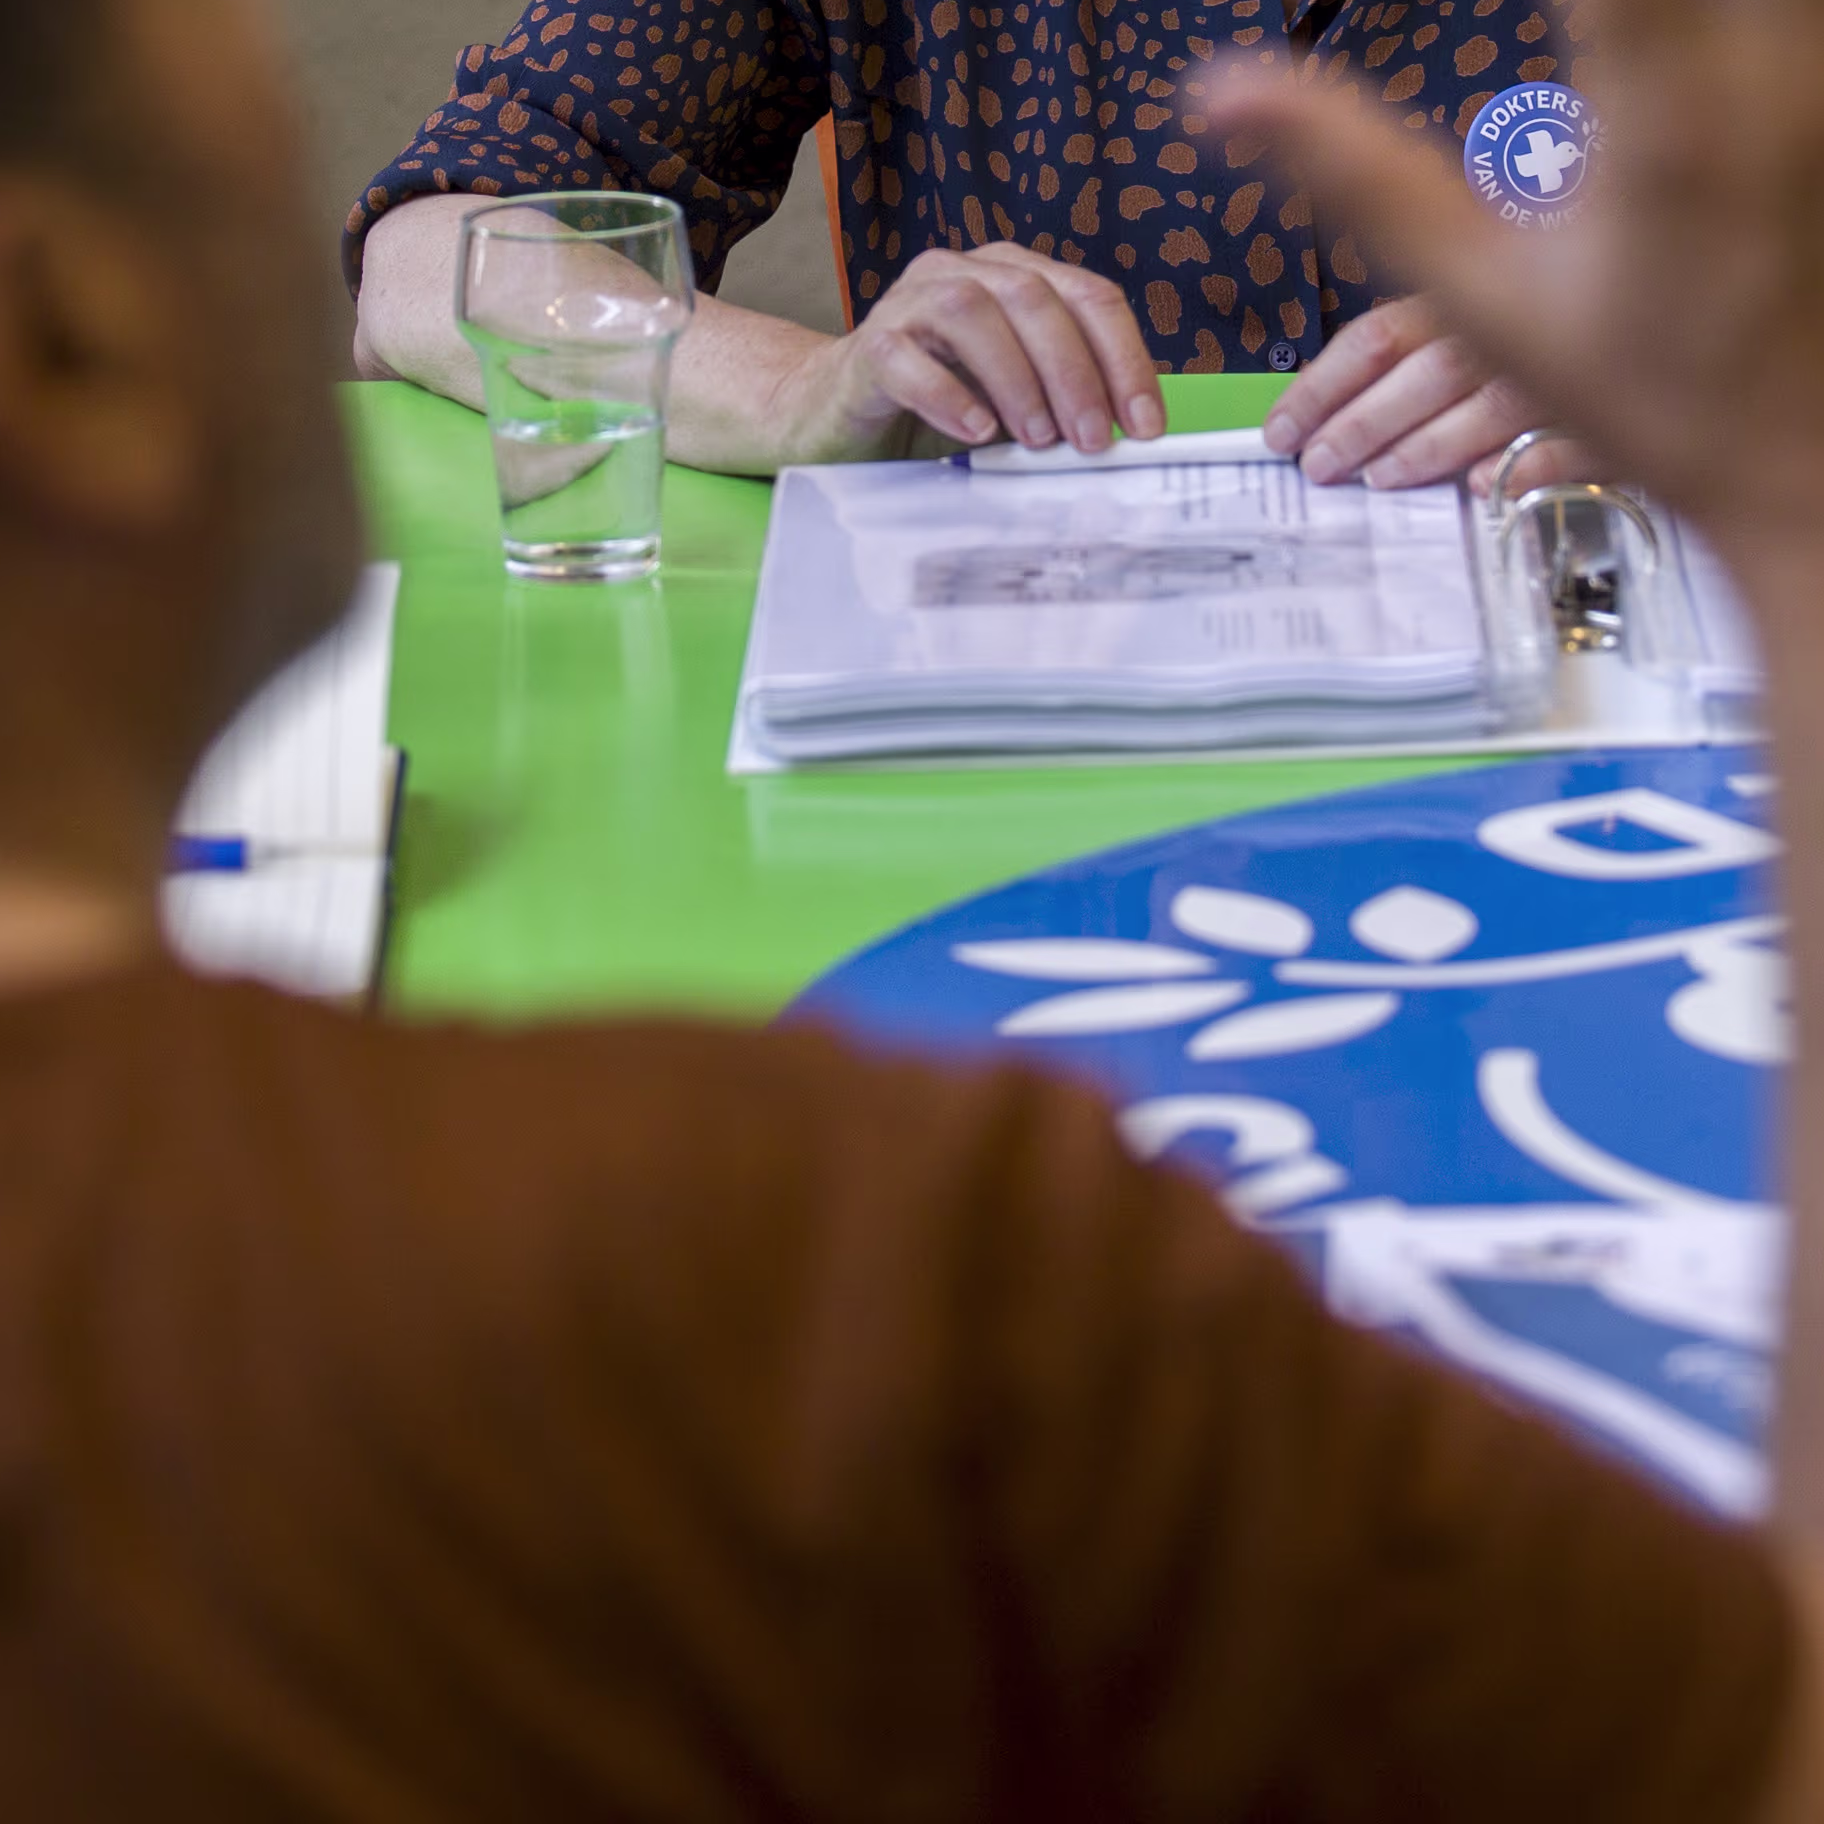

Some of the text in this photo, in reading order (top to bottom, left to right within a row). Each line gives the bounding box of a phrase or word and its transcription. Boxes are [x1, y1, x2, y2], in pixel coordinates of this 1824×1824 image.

[1473, 89, 1585, 229] DOKTERS VAN DE
